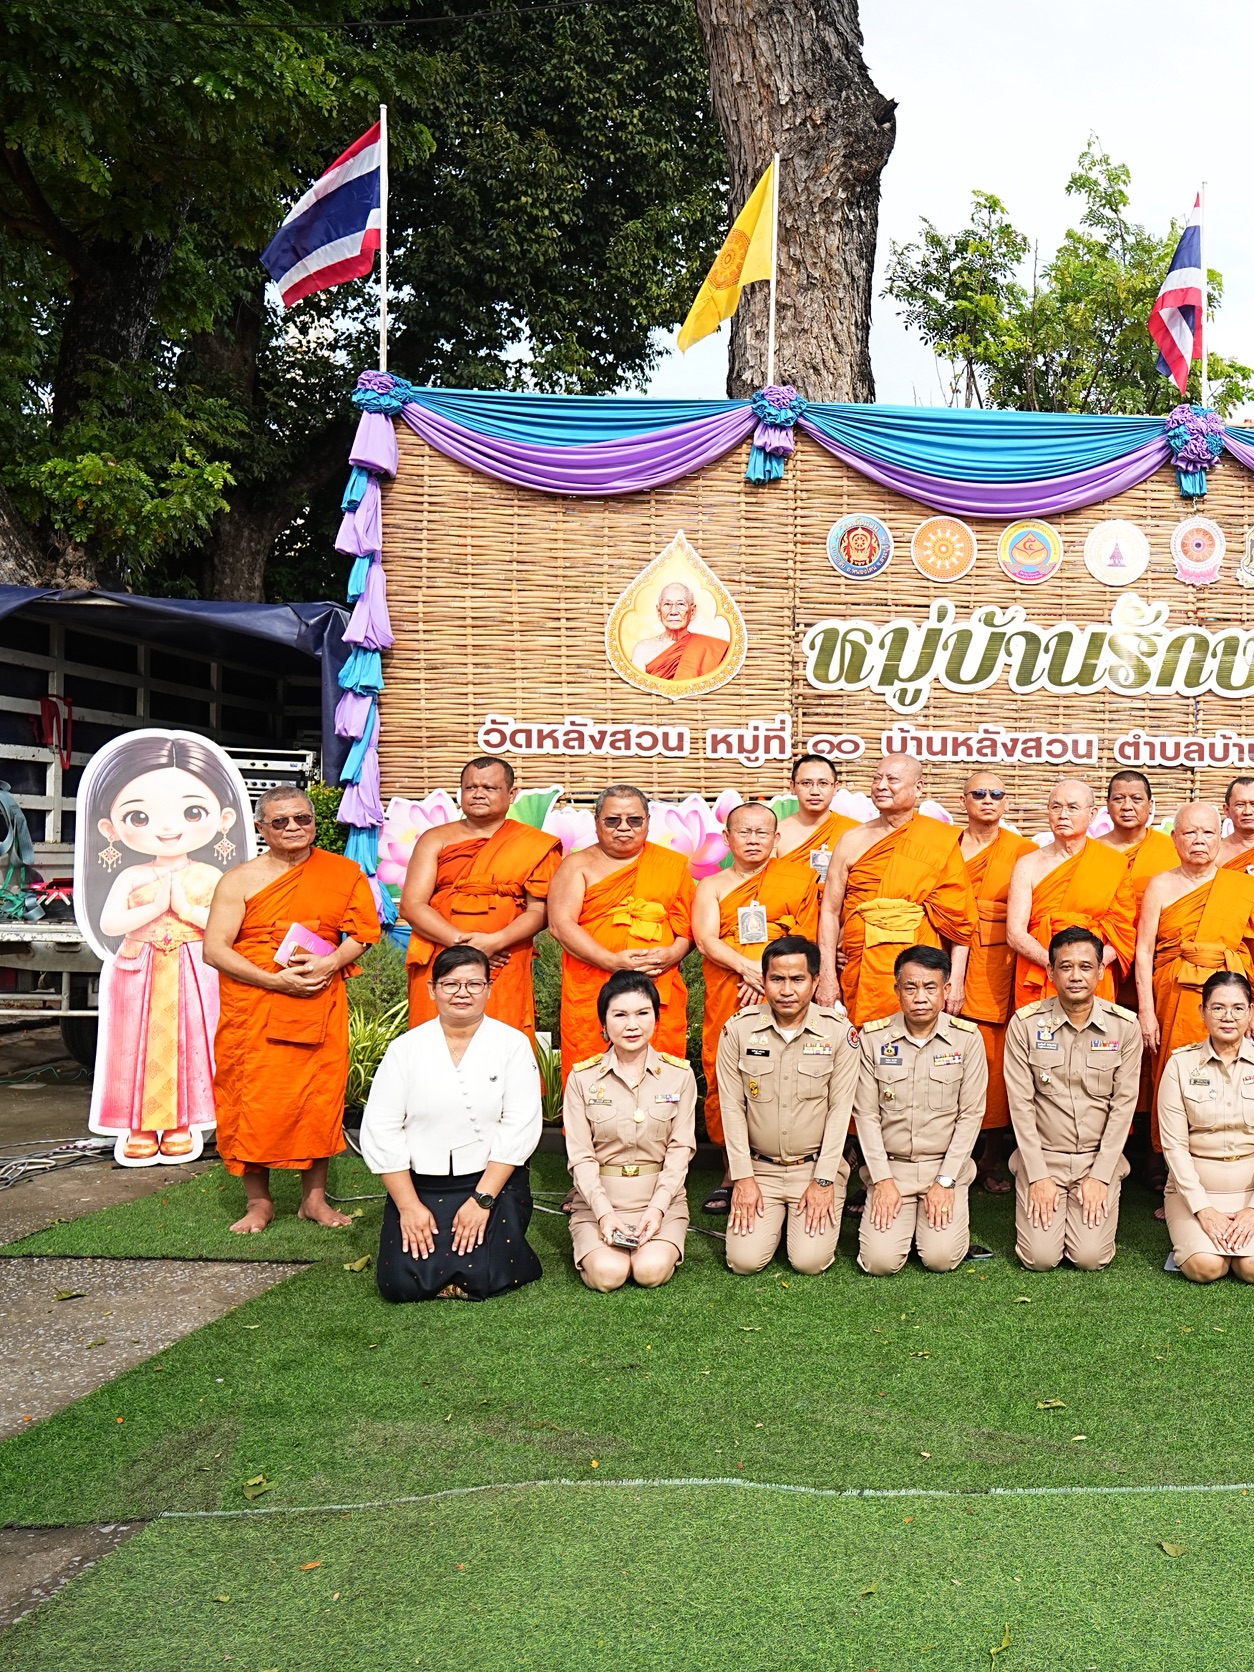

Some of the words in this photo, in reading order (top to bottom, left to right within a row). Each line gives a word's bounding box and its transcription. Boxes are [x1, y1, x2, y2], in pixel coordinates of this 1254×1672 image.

[483, 719, 684, 752] วัดหลังสวน
[711, 718, 786, 762] หมู่ที่
[812, 739, 861, 755] ๑๐
[886, 727, 1093, 759] บ้านหลังสวน
